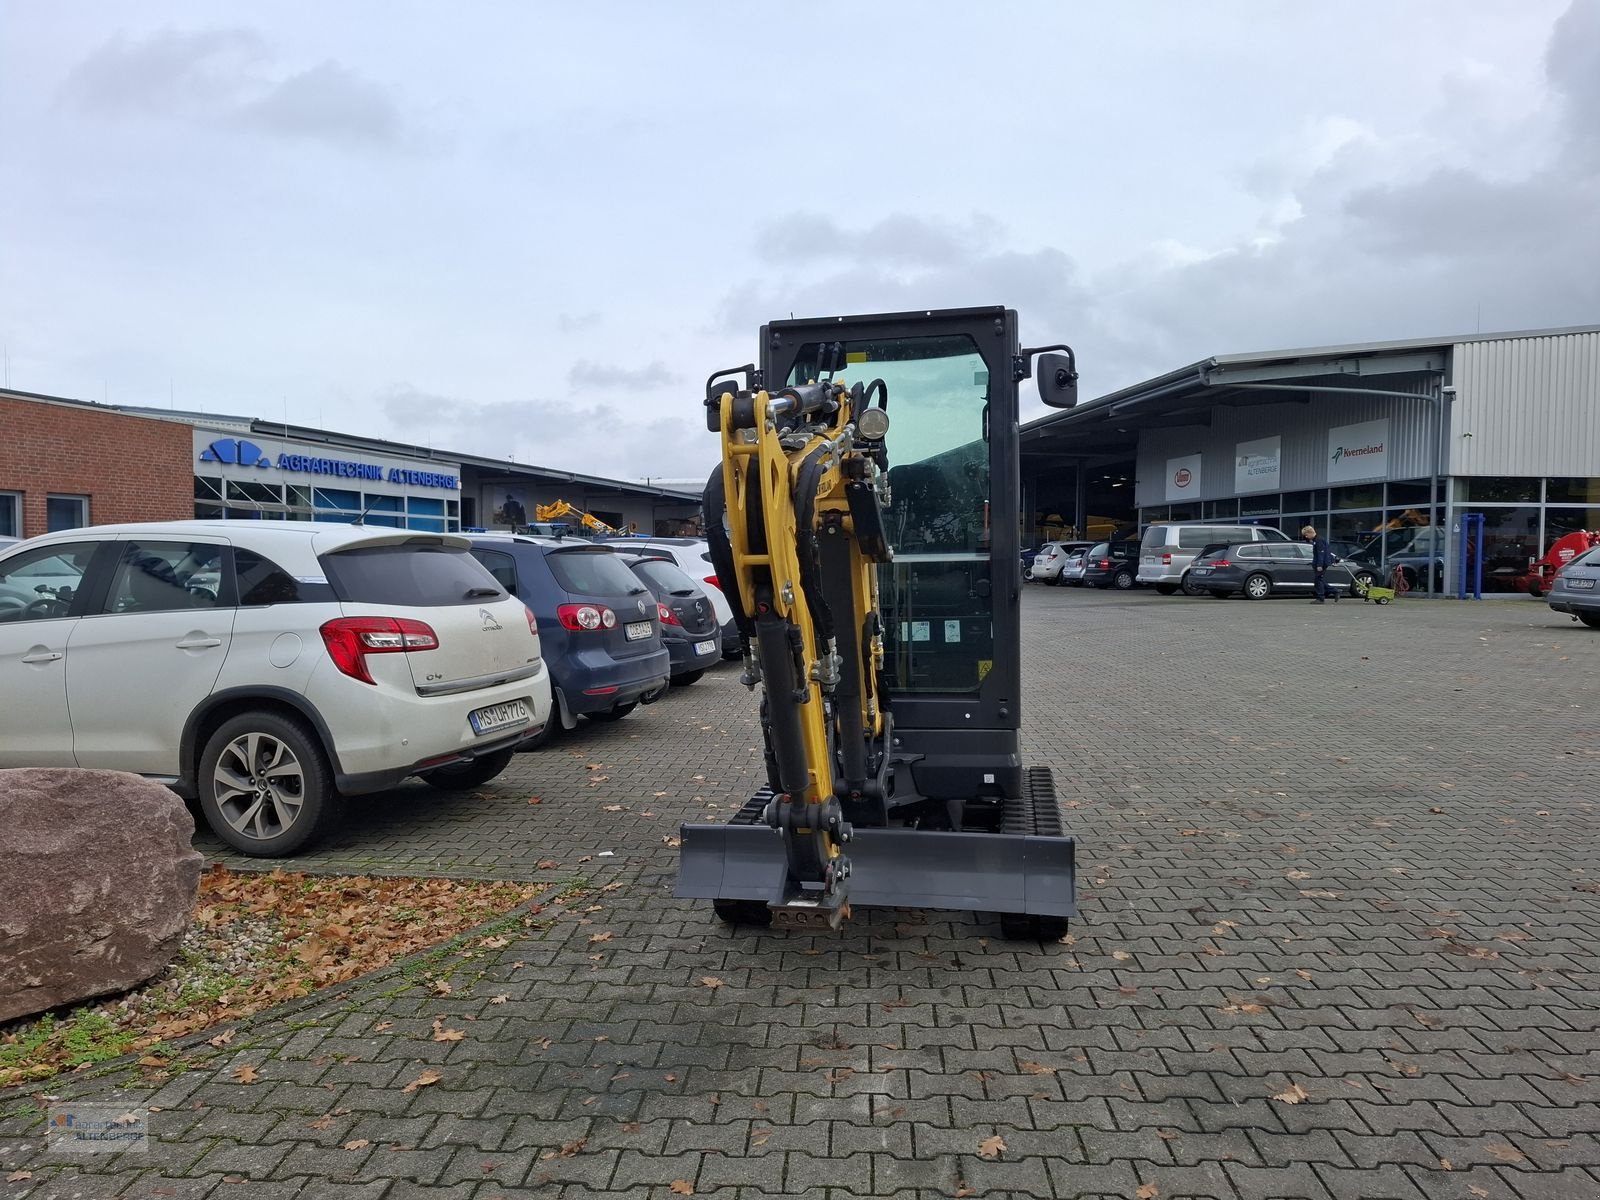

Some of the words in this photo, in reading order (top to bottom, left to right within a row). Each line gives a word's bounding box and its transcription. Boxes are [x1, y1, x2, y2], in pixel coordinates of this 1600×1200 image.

[1343, 442, 1384, 458] Kverneland
[278, 453, 384, 481] AGRARTECHNIK
[388, 467, 461, 490] ALTENBERGE
